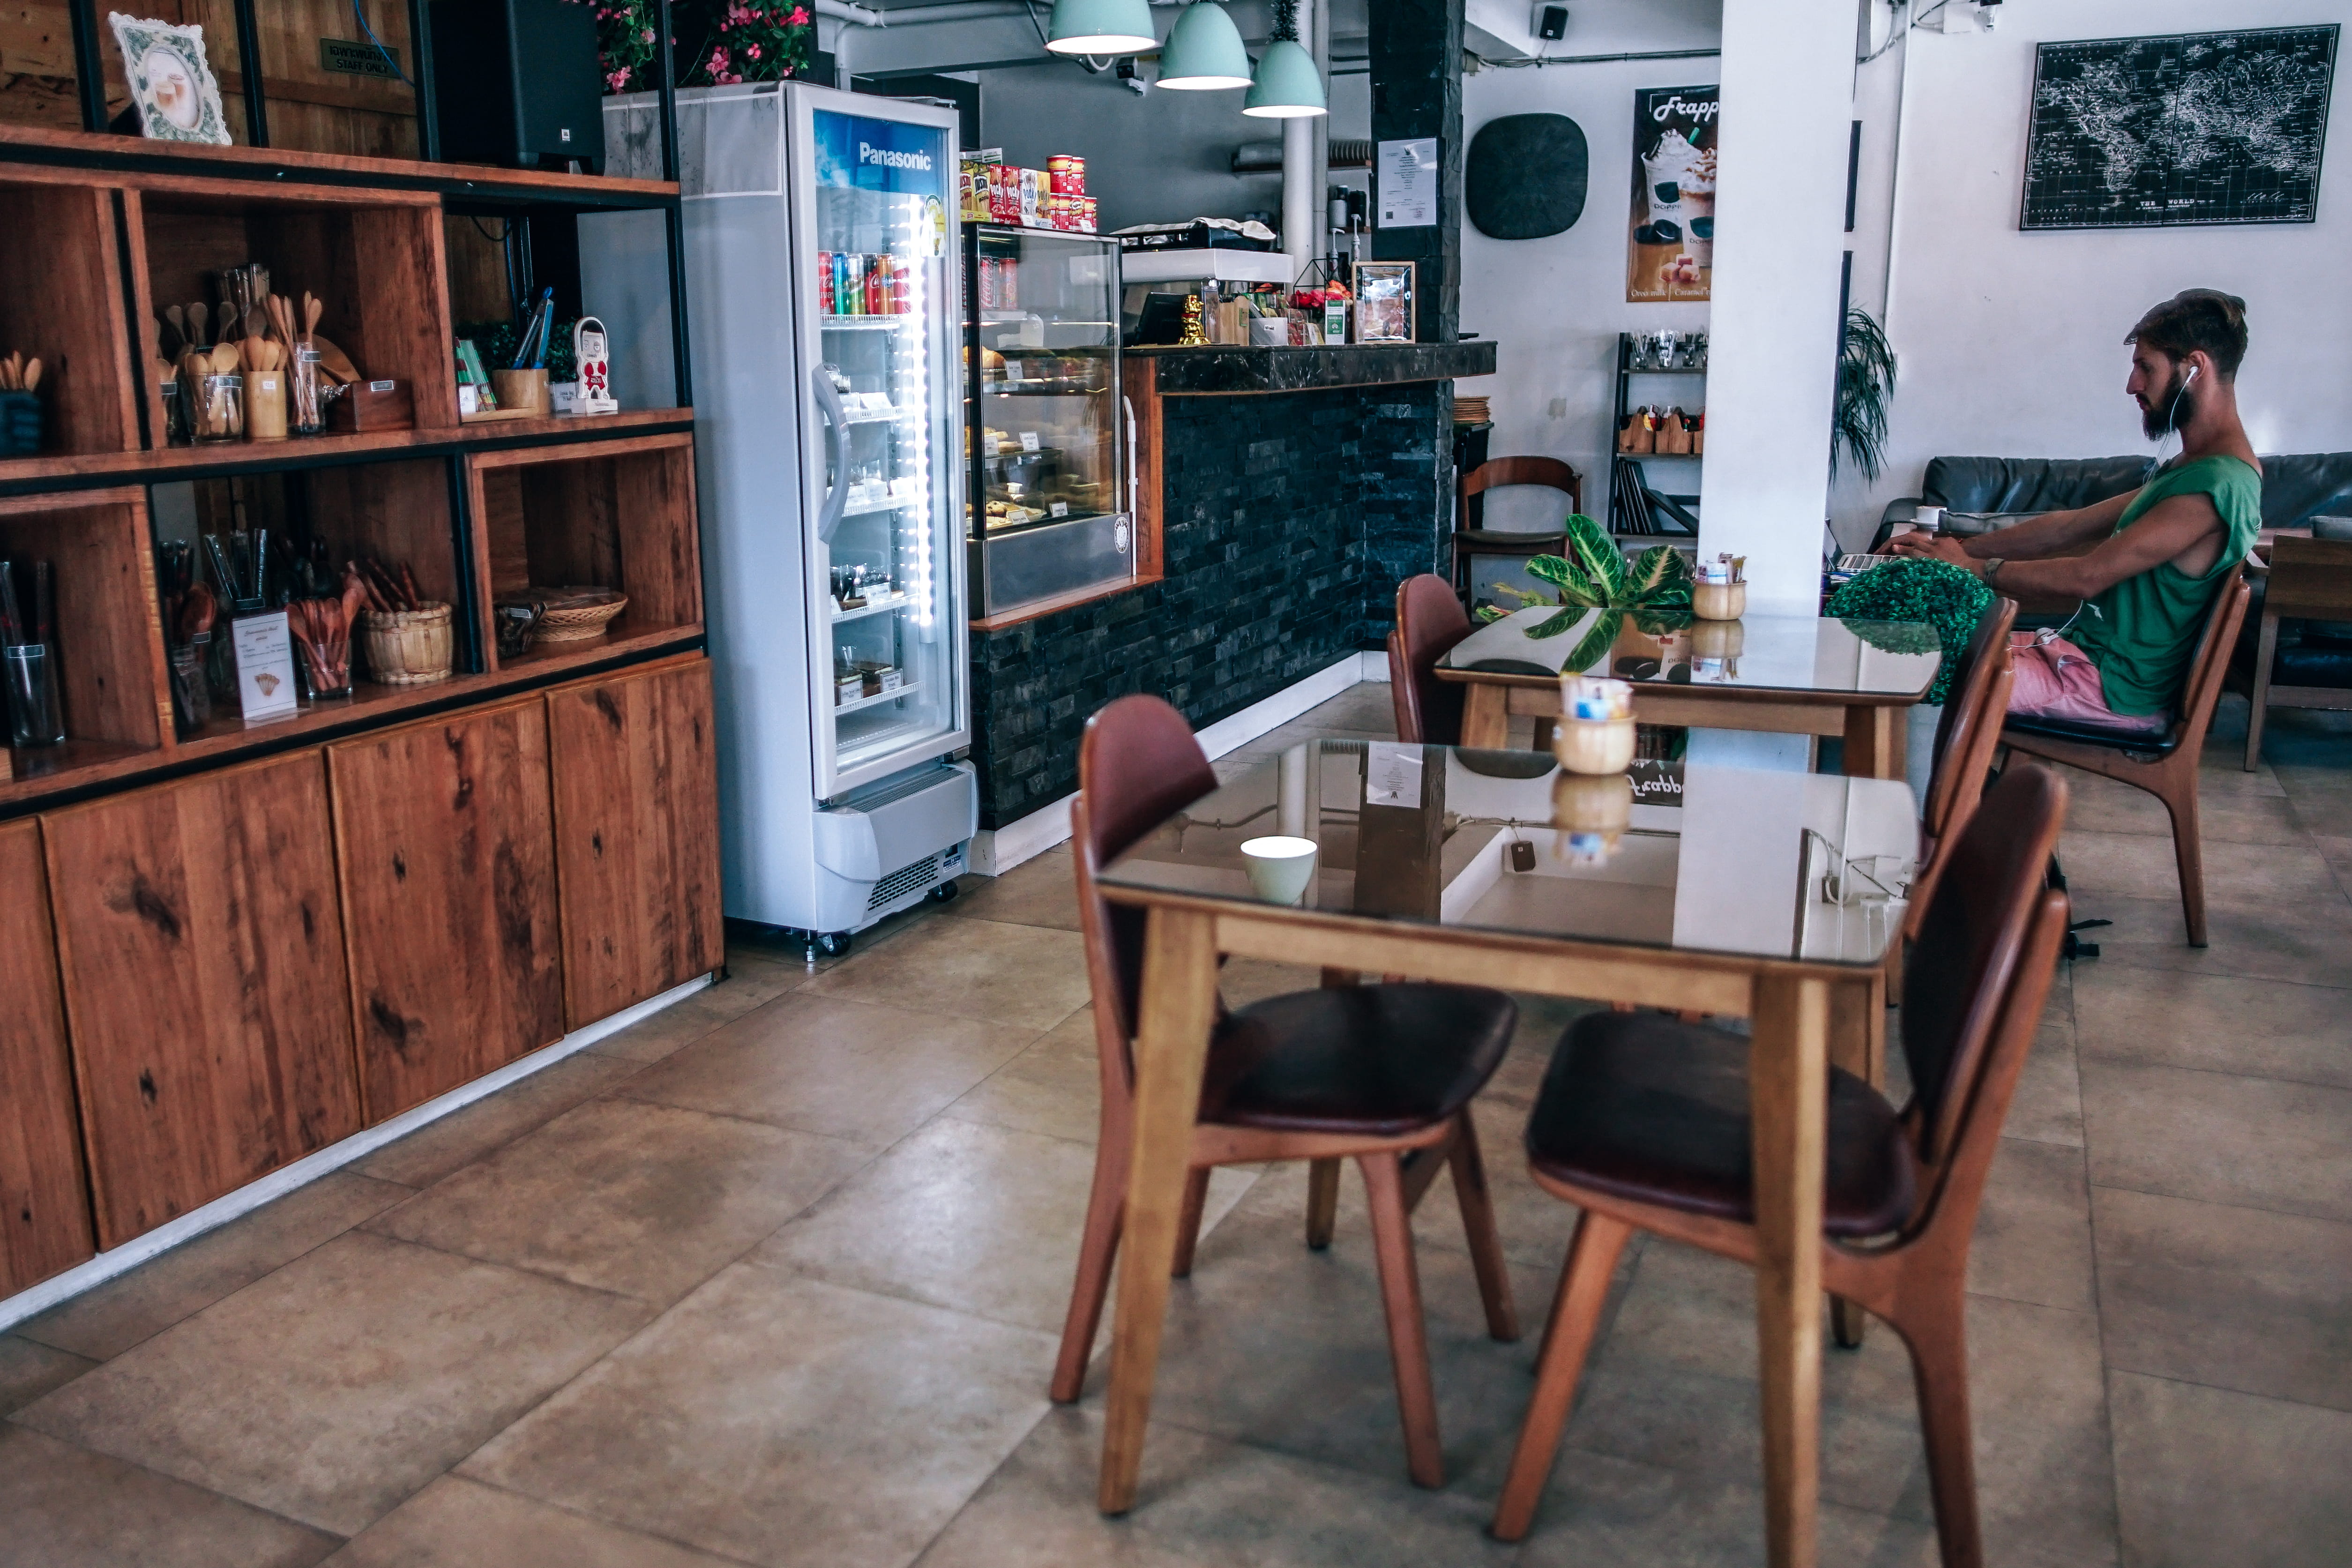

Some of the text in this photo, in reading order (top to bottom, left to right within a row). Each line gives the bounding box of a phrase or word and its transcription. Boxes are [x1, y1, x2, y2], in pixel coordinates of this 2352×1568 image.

[336, 59, 388, 74] STAFF ONLY
[1653, 96, 1719, 123] Frapp
[860, 142, 932, 171] Panasonic
